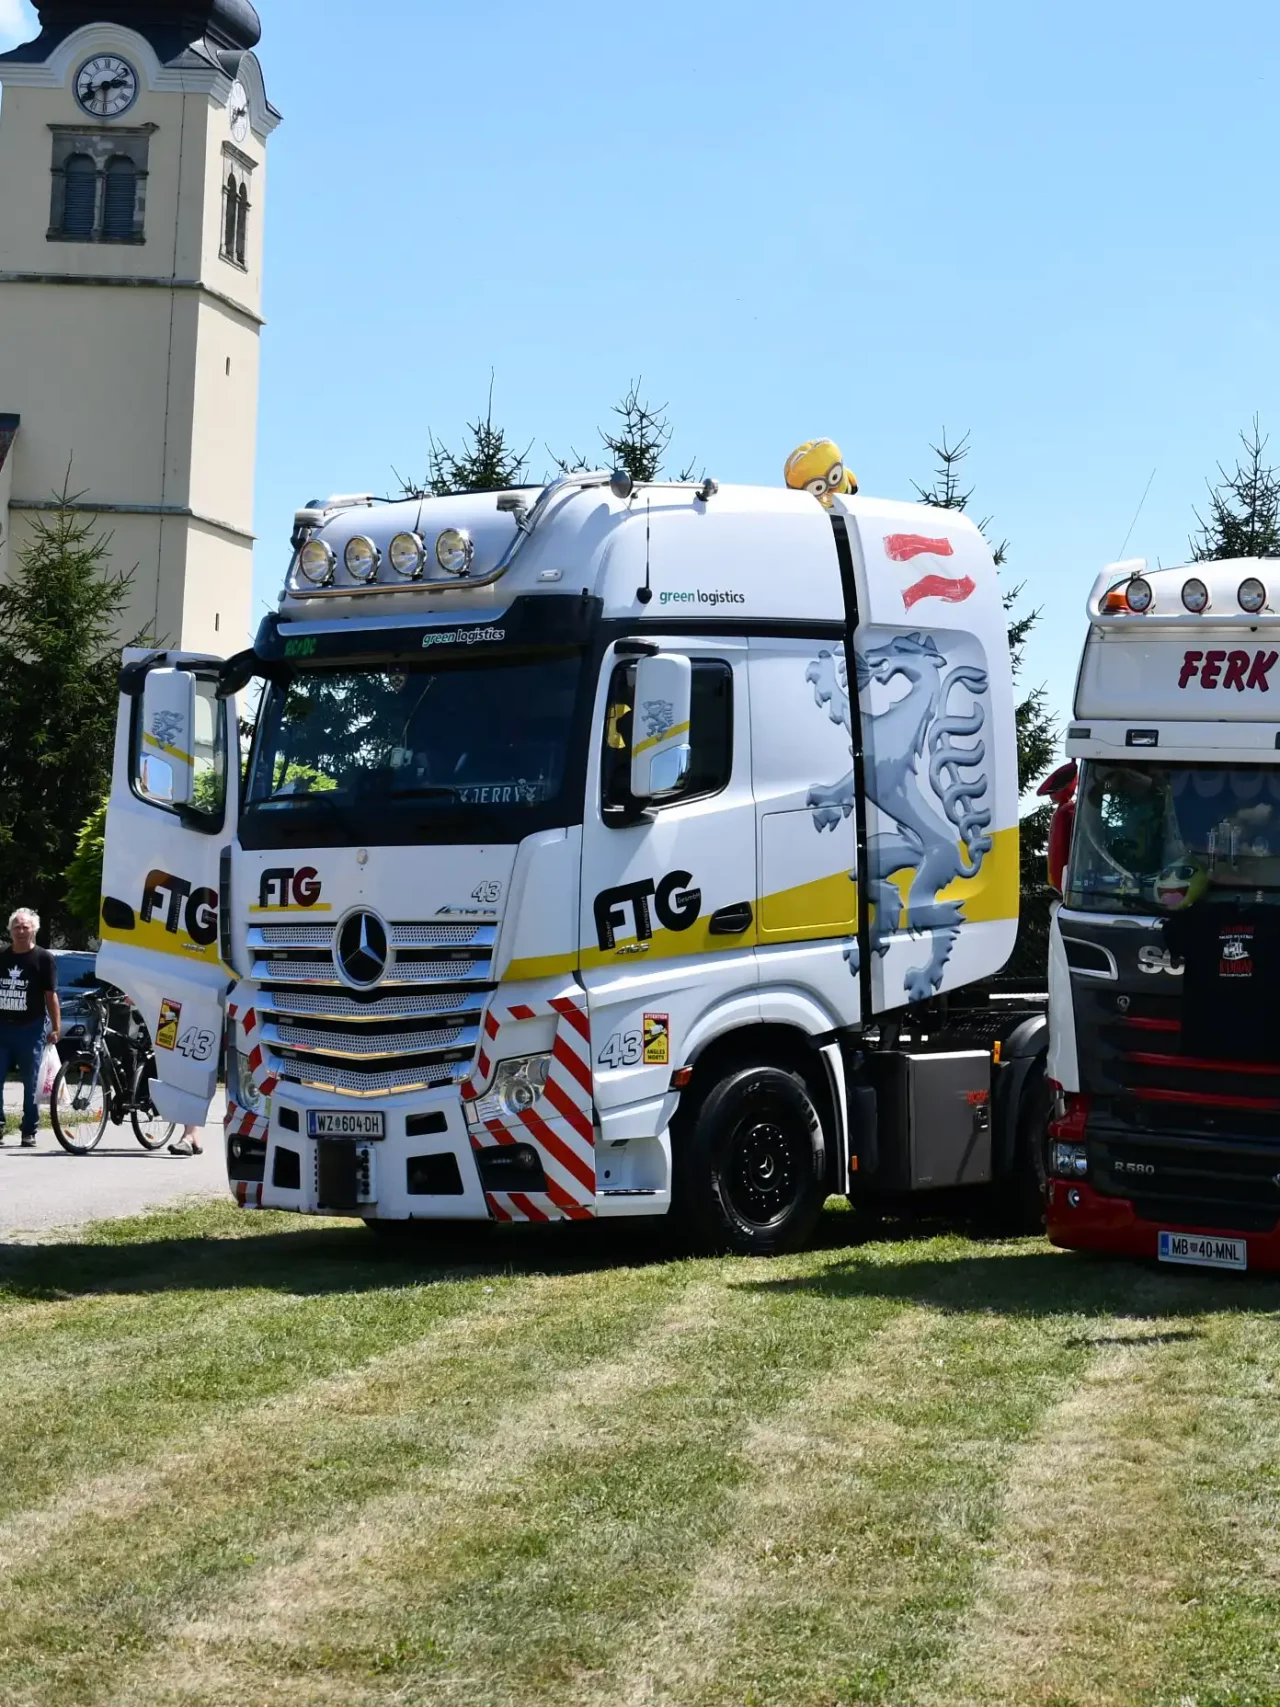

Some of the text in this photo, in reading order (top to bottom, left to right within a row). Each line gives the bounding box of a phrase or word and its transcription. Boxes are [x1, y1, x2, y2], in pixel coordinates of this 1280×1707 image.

[659, 589, 745, 606] green logistics
[421, 627, 506, 648] green logistics
[1178, 650, 1280, 693] FERK
[259, 866, 321, 908] FTG
[471, 880, 502, 903] 43
[140, 869, 218, 946] FTG
[593, 869, 702, 952] FTG
[176, 1026, 216, 1062] 43
[598, 1029, 643, 1069] 43
[317, 1115, 334, 1132] WZ
[1126, 1162, 1155, 1176] 580
[1172, 1238, 1189, 1256] MB
